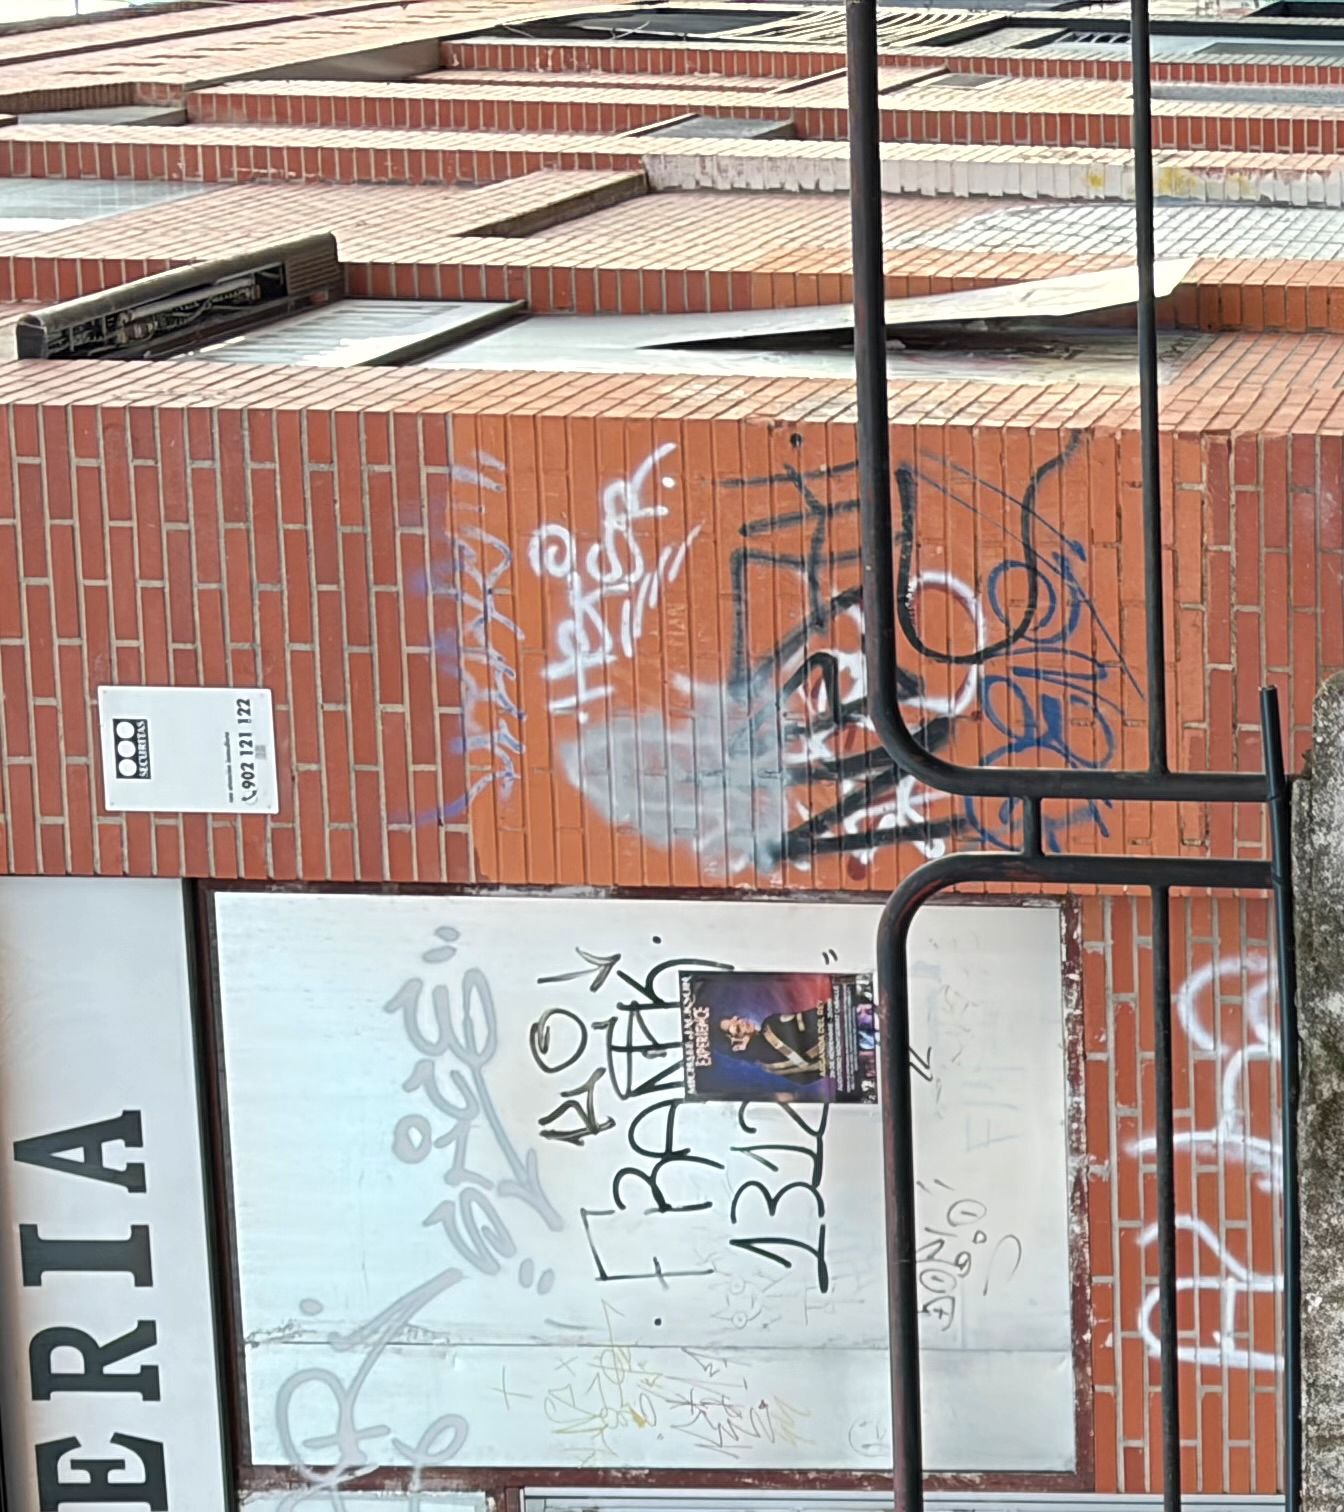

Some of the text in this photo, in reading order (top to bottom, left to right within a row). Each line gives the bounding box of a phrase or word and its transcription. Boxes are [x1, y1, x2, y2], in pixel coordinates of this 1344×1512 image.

[136, 720, 149, 777] SECURITAS
[236, 698, 255, 790] 902 121 122
[693, 1007, 711, 1066] EXPERIENCE
[816, 1000, 824, 1015] REY
[817, 1017, 825, 1034] DEL
[729, 1101, 829, 1293] 1312
